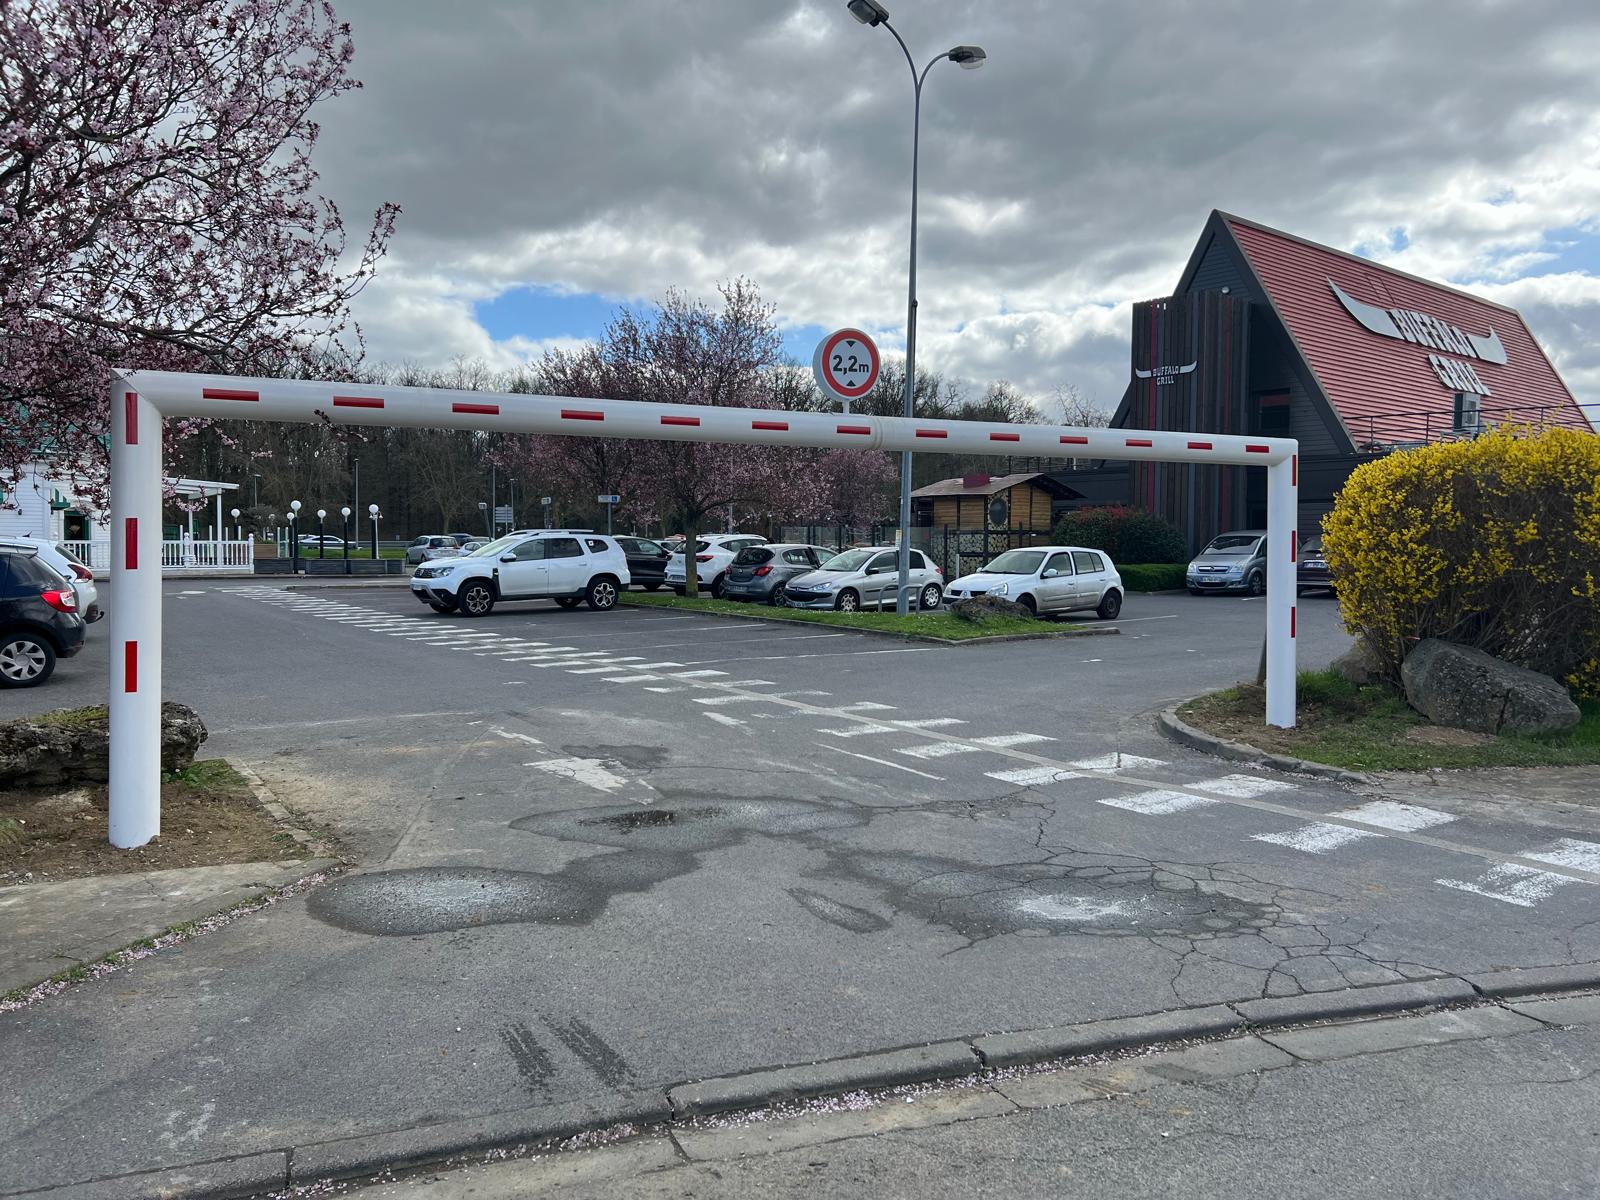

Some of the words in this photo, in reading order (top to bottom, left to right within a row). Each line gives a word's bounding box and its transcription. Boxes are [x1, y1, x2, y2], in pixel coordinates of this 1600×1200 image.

[1389, 308, 1477, 358] BUFFALO
[833, 354, 869, 375] 2,2m
[1152, 365, 1179, 377] BUFFALO
[1428, 353, 1492, 396] GRILL
[1156, 375, 1175, 386] GRILL
